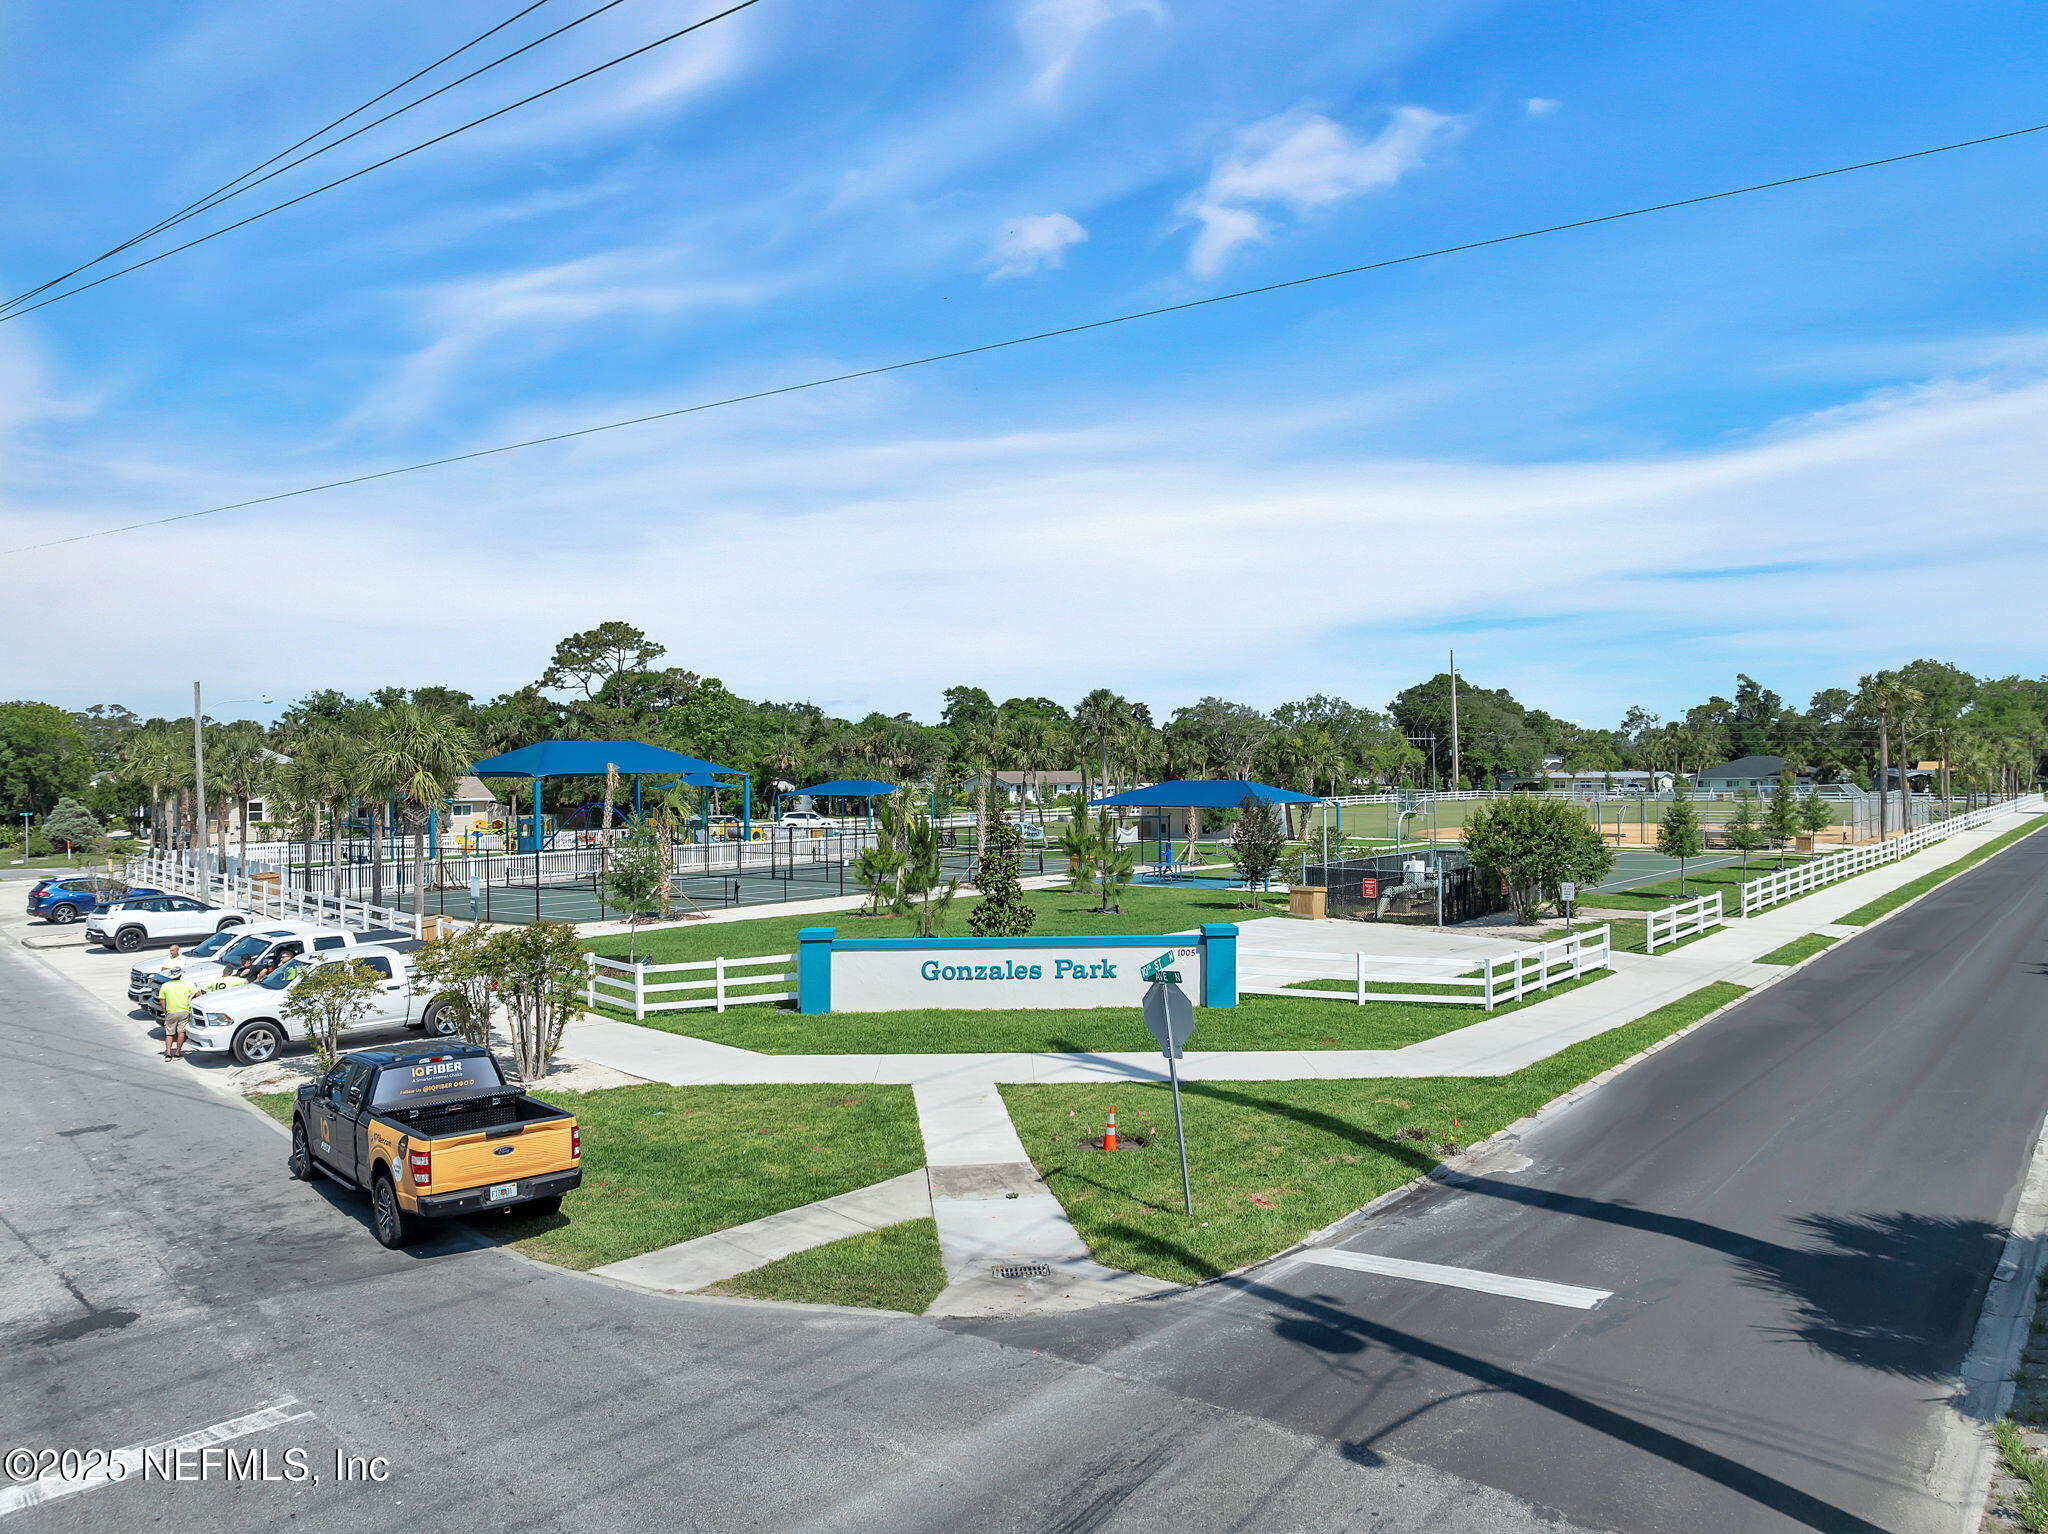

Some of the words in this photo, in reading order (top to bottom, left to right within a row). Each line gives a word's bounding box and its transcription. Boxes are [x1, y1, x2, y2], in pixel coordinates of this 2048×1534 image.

[921, 960, 1043, 981] Gonzales
[1054, 958, 1117, 979] Park
[1153, 959, 1163, 970] ST
[1168, 952, 1174, 961] N
[1174, 972, 1181, 982] N
[411, 1066, 425, 1077] IQ
[425, 1061, 463, 1075] FIBER
